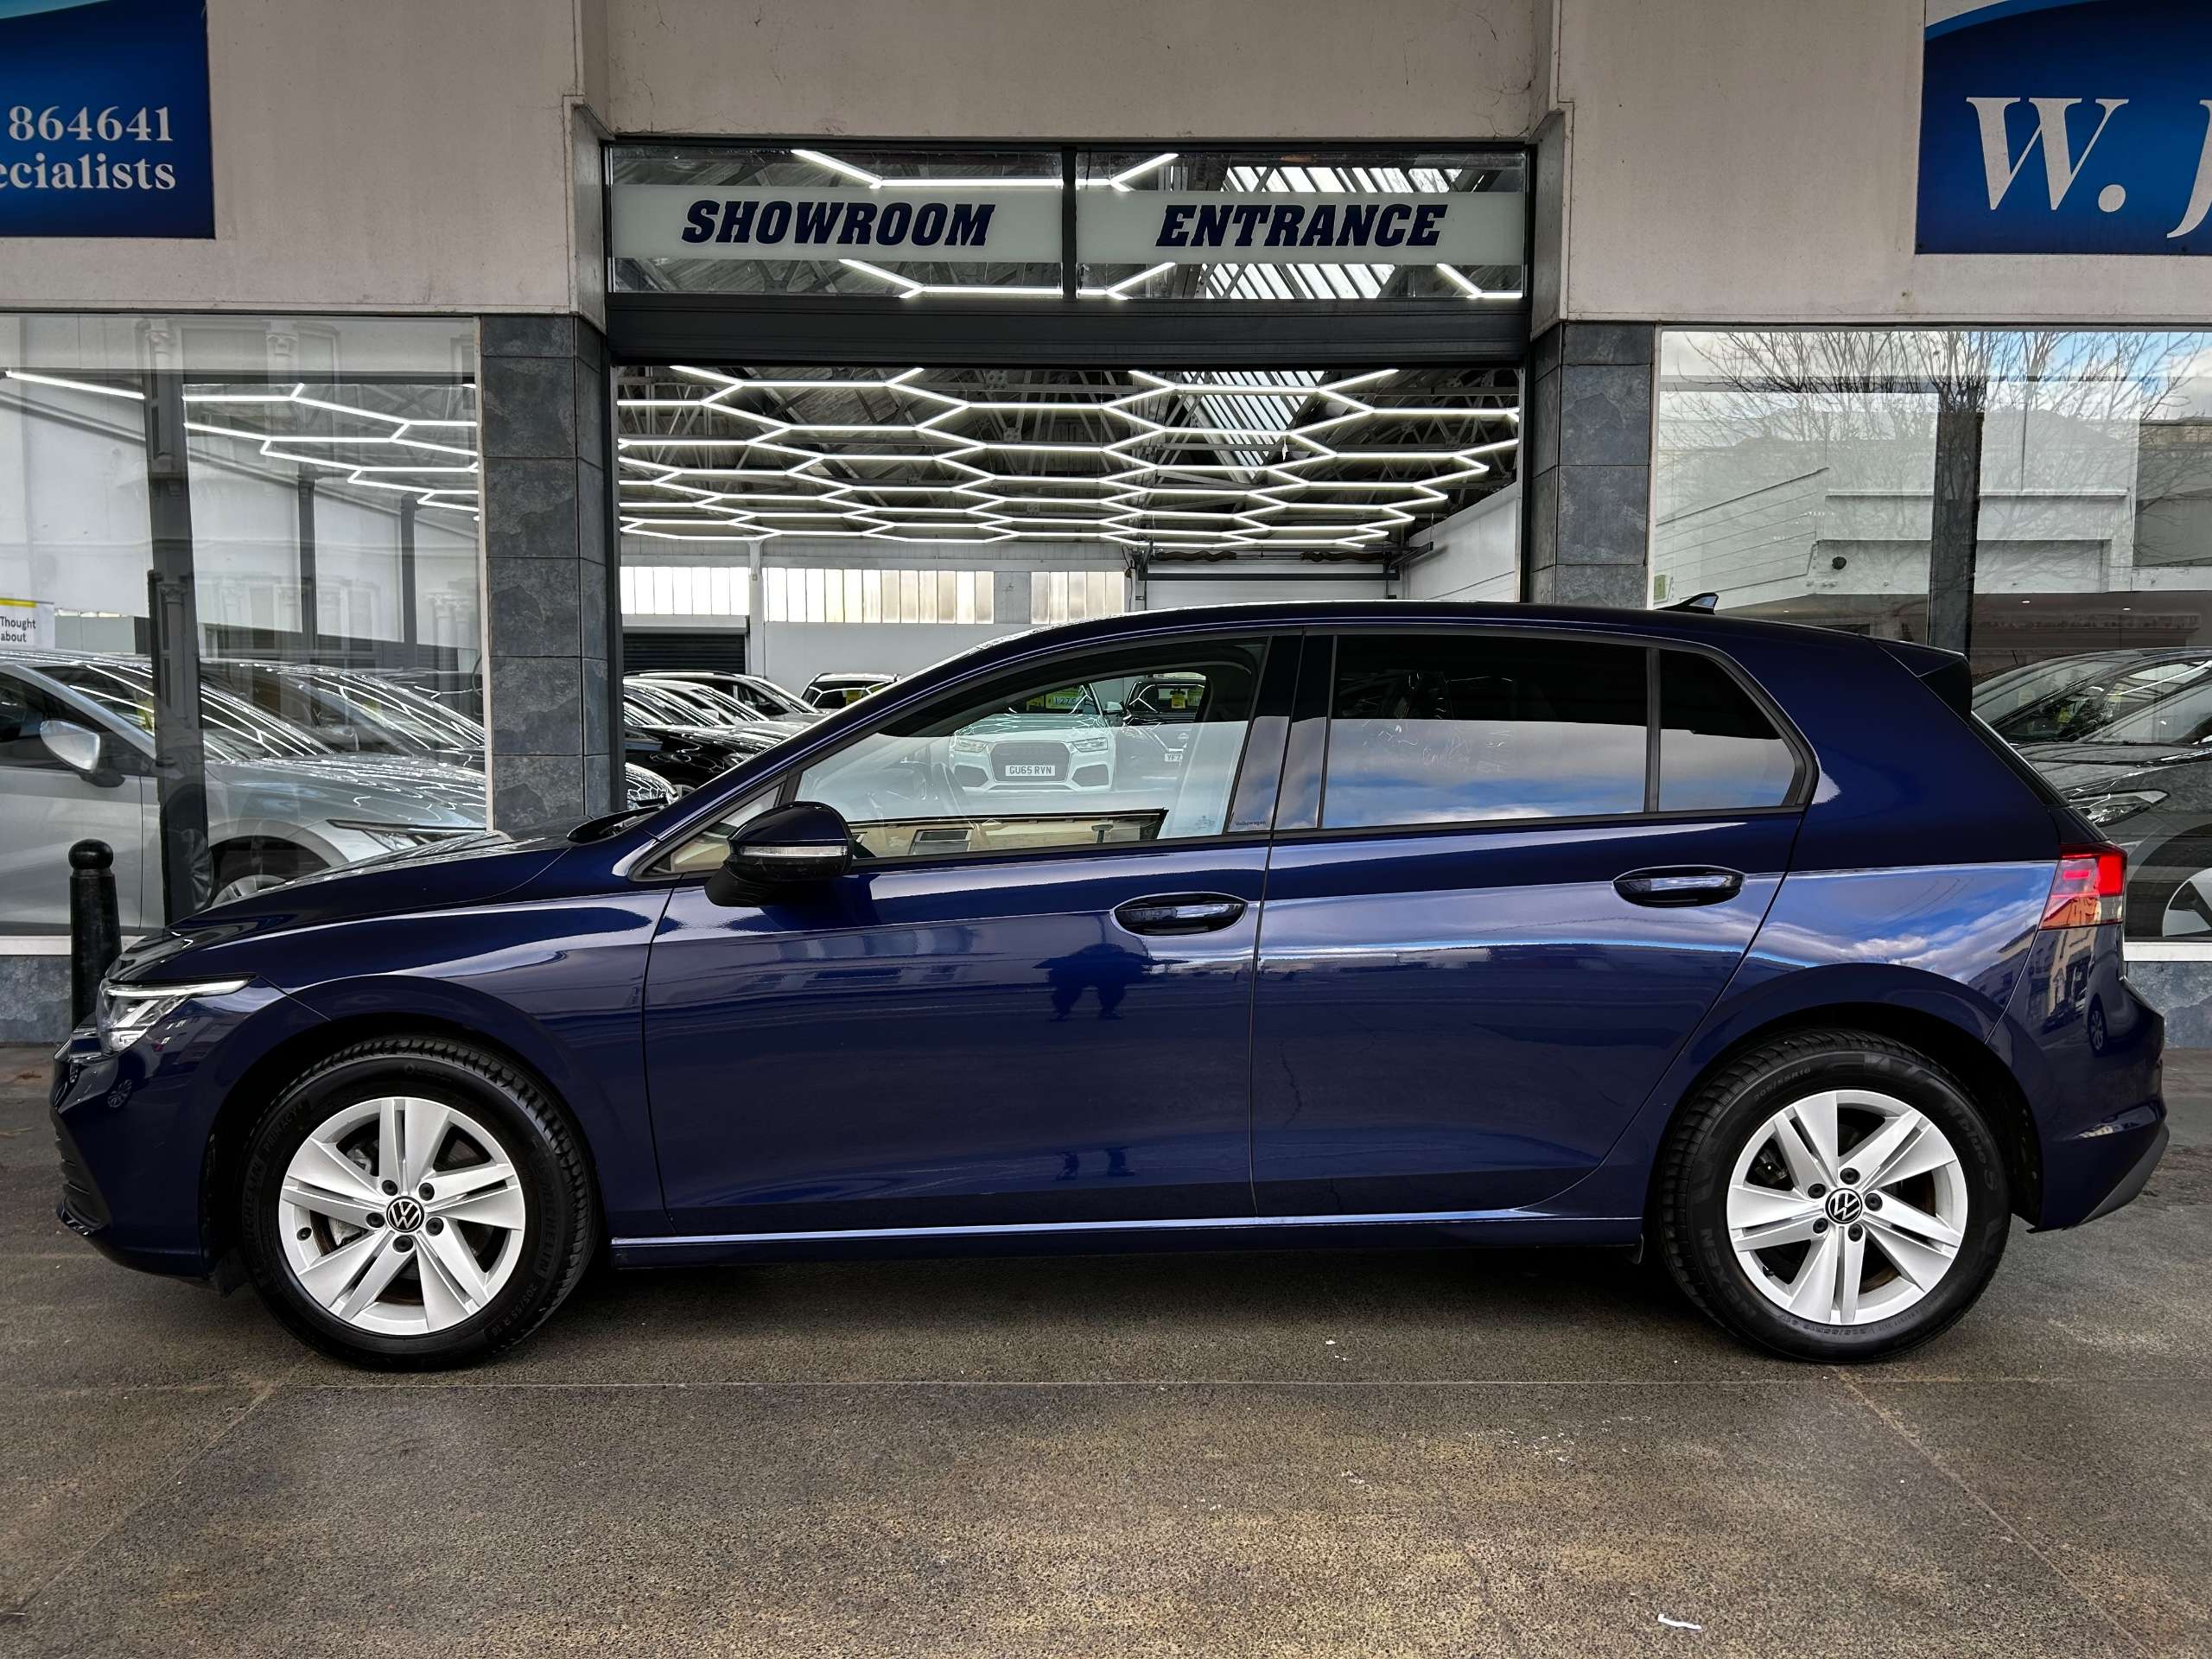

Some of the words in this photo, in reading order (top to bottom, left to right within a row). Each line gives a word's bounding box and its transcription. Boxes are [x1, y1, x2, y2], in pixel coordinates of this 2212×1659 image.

[9, 105, 173, 142] 864641
[1966, 97, 2129, 213] W.
[682, 200, 996, 246] SHOWROOM
[1155, 203, 1448, 247] ENTRANCE
[0, 616, 36, 631] Thought
[1, 632, 27, 642] about
[1009, 766, 1033, 774] GU65
[1034, 766, 1052, 774] RVN
